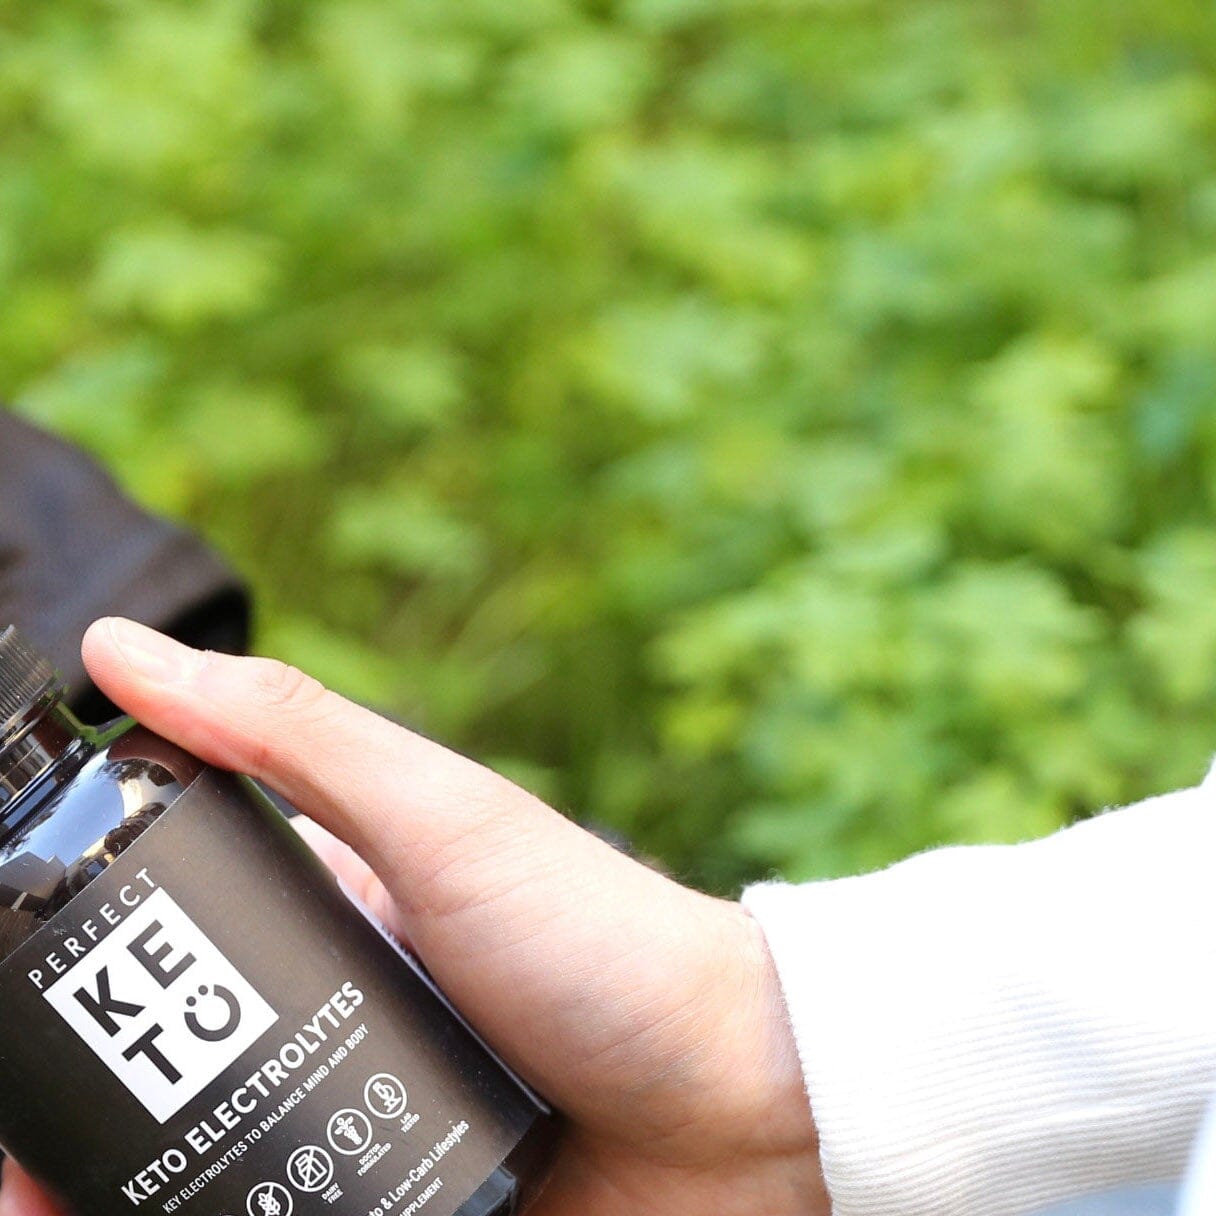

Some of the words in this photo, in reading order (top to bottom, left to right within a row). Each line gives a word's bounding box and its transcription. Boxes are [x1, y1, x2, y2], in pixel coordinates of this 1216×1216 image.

[27, 867, 155, 989] PERFECT
[121, 1149, 187, 1206] KETO
[185, 981, 364, 1155] ELECTROLYTES
[162, 1195, 182, 1214] KEY
[180, 1140, 248, 1201] ELECTROLYTES
[245, 1128, 262, 1145] TO
[259, 1087, 307, 1133] BALANCE
[301, 1065, 330, 1092] MIND
[327, 1047, 348, 1069] AND
[345, 1023, 369, 1049] BODY
[321, 1182, 339, 1200] DAIRY
[328, 1190, 344, 1204] FREE
[359, 1143, 382, 1165] DOCTOR
[380, 1197, 394, 1210] &
[388, 1158, 434, 1202] Low-Carb
[429, 1120, 470, 1162] Lifestyles
